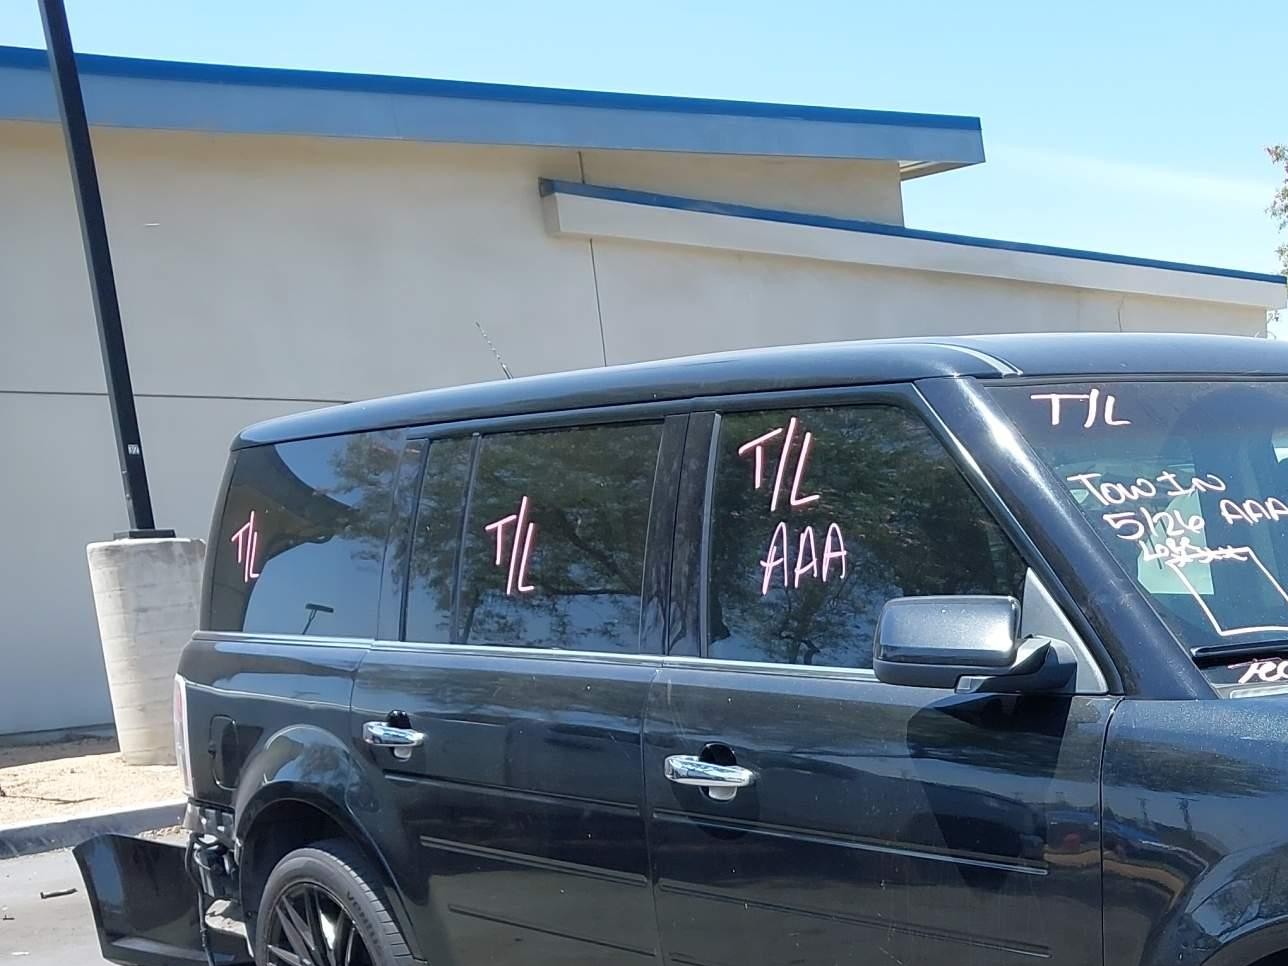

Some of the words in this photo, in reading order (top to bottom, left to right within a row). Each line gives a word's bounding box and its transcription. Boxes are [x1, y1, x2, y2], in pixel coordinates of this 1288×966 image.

[1030, 388, 1132, 429] T/L
[738, 416, 820, 512] T/L
[1067, 473, 1156, 506] Tow
[231, 509, 260, 583] T/L
[484, 495, 535, 596] T/L
[759, 521, 848, 596] AAA
[1102, 507, 1205, 540] 5/26
